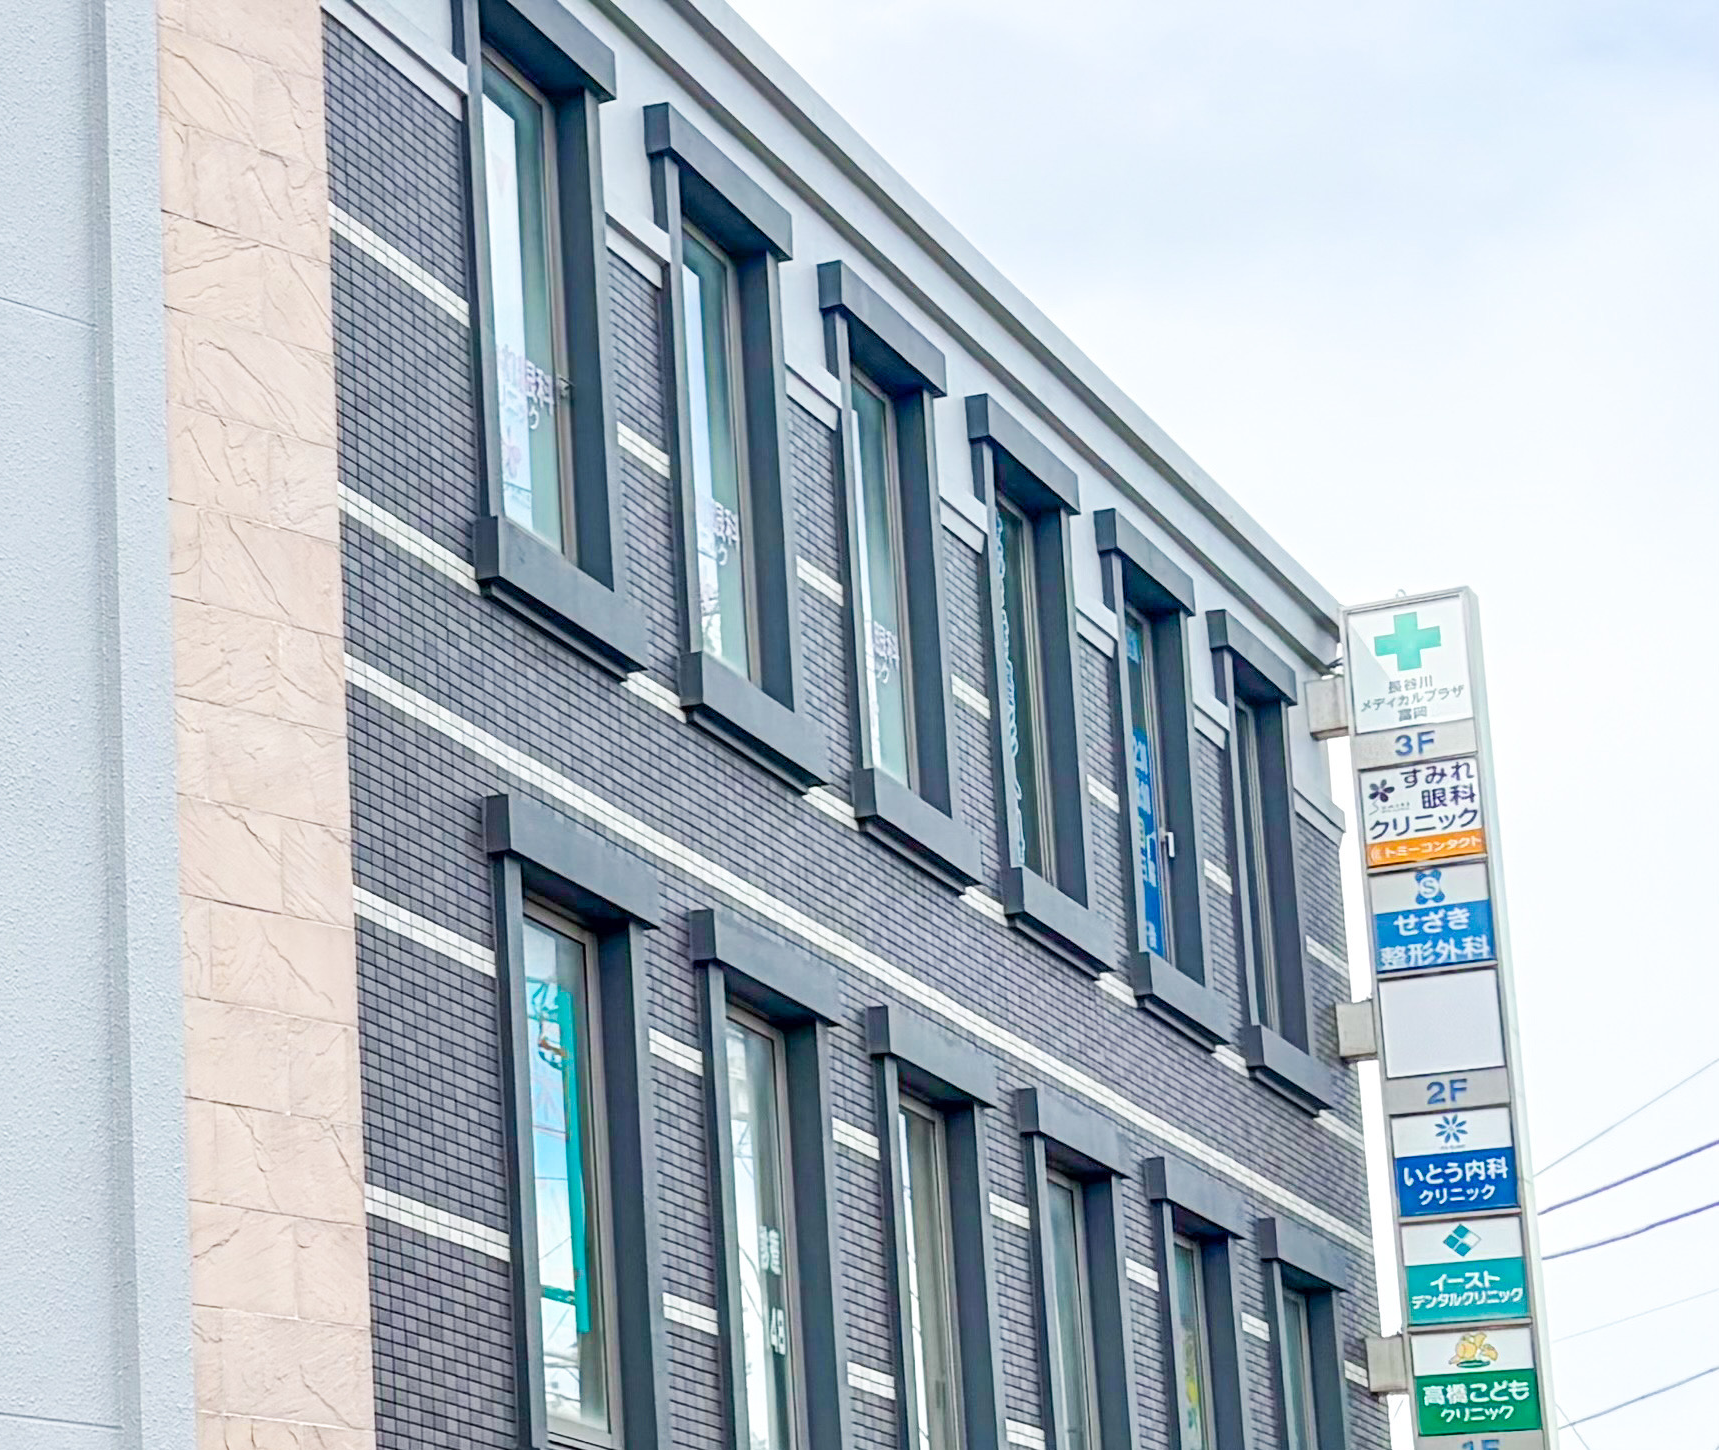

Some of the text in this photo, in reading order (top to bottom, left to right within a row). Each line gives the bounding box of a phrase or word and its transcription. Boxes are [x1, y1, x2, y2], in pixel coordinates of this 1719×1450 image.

[1361, 684, 1464, 712] メディカルプラザ
[1388, 675, 1433, 695] 長谷川
[1397, 706, 1428, 722] 富岡
[1394, 730, 1435, 757] 3F
[1399, 761, 1475, 790] すみれ
[1421, 783, 1477, 810] 眼科
[1369, 807, 1478, 840] クリニック
[1383, 835, 1482, 858] トミーコンタクト
[1393, 907, 1470, 936] せざき
[1380, 935, 1491, 970] 整形外科
[1426, 1078, 1467, 1105] 2F
[1403, 1157, 1508, 1187] いとう内科
[1418, 1183, 1497, 1206] クリニック
[1430, 1271, 1501, 1292] イースト
[1411, 1286, 1524, 1310] デンタルクリニック
[1423, 1379, 1531, 1406] 高橋こども
[1440, 1404, 1515, 1423] クリニック
